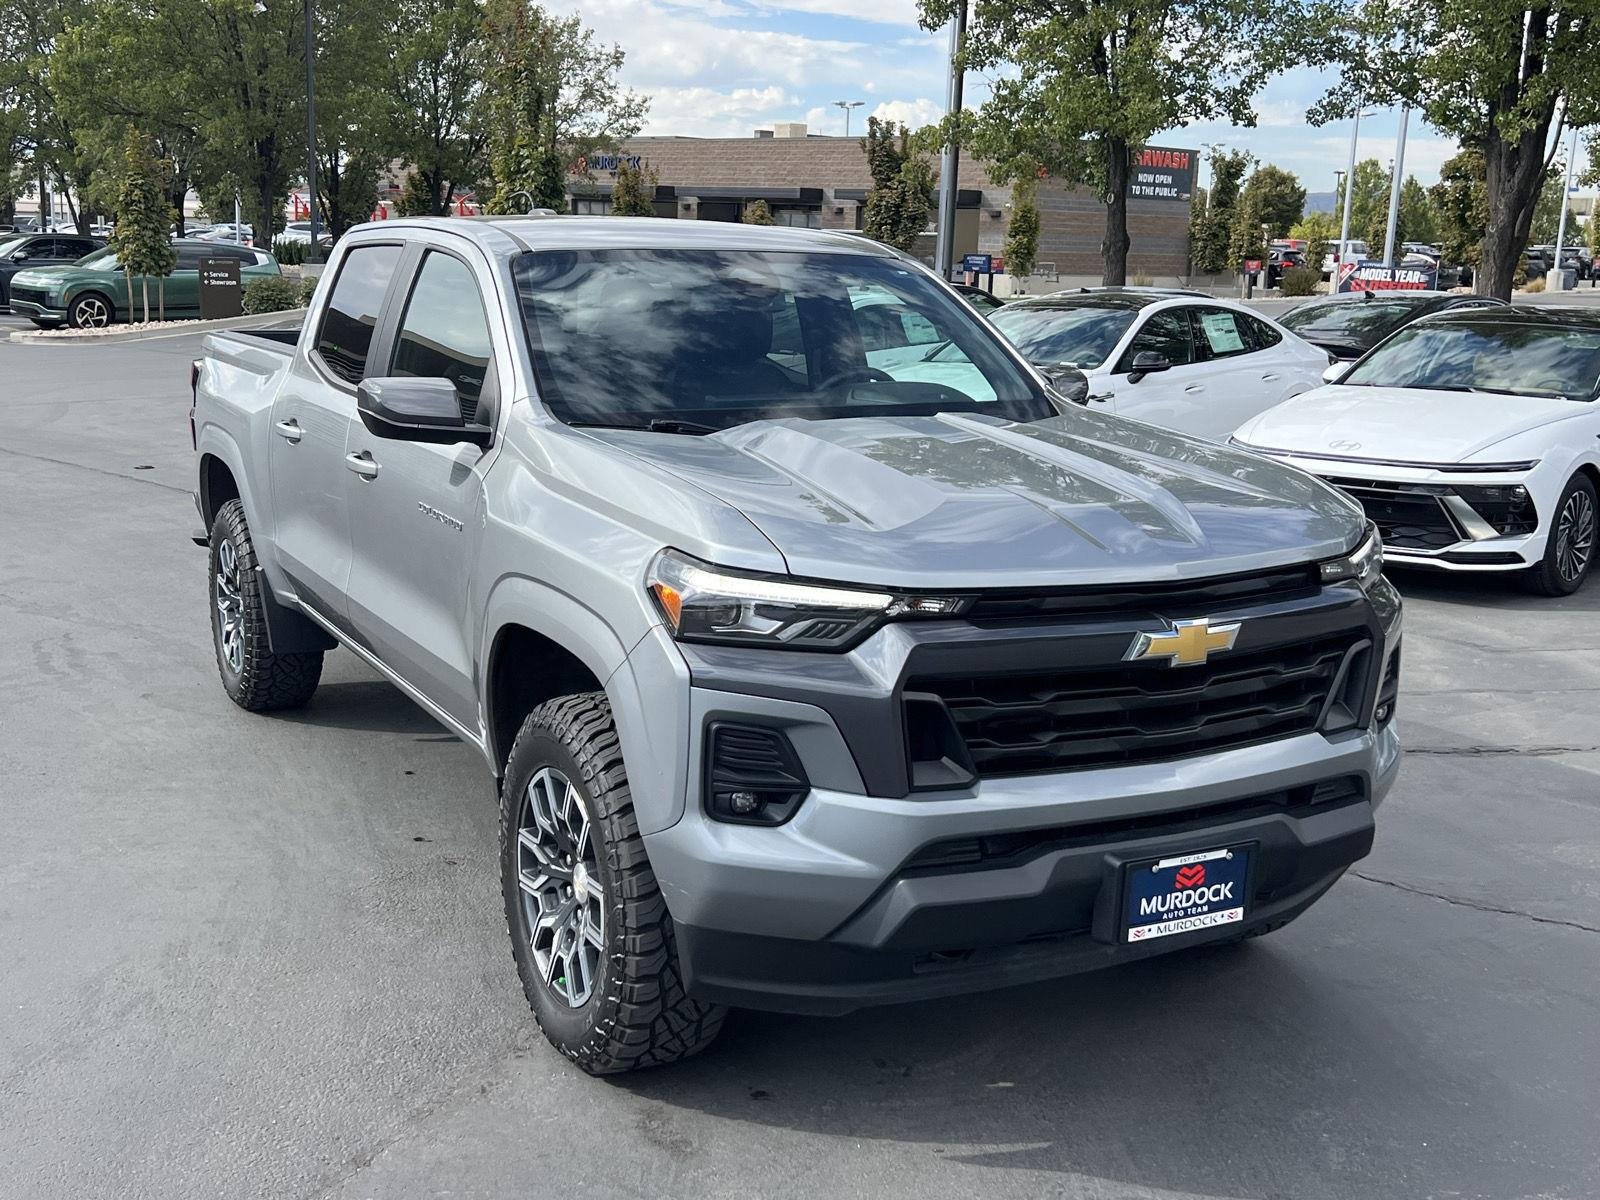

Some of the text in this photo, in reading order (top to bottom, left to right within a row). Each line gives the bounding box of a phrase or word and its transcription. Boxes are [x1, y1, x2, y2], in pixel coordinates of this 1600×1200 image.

[1138, 173, 1173, 185] NOW OPEN
[1131, 185, 1140, 195] TO
[1142, 186, 1154, 196] THE
[1155, 187, 1178, 197] PUBLIC
[1360, 267, 1392, 281] MODEL
[1395, 269, 1421, 284] YEAR
[1140, 881, 1234, 915] MURDOCK
[1162, 905, 1209, 920] AUTO TEAM
[1156, 914, 1218, 935] MURDOCK
